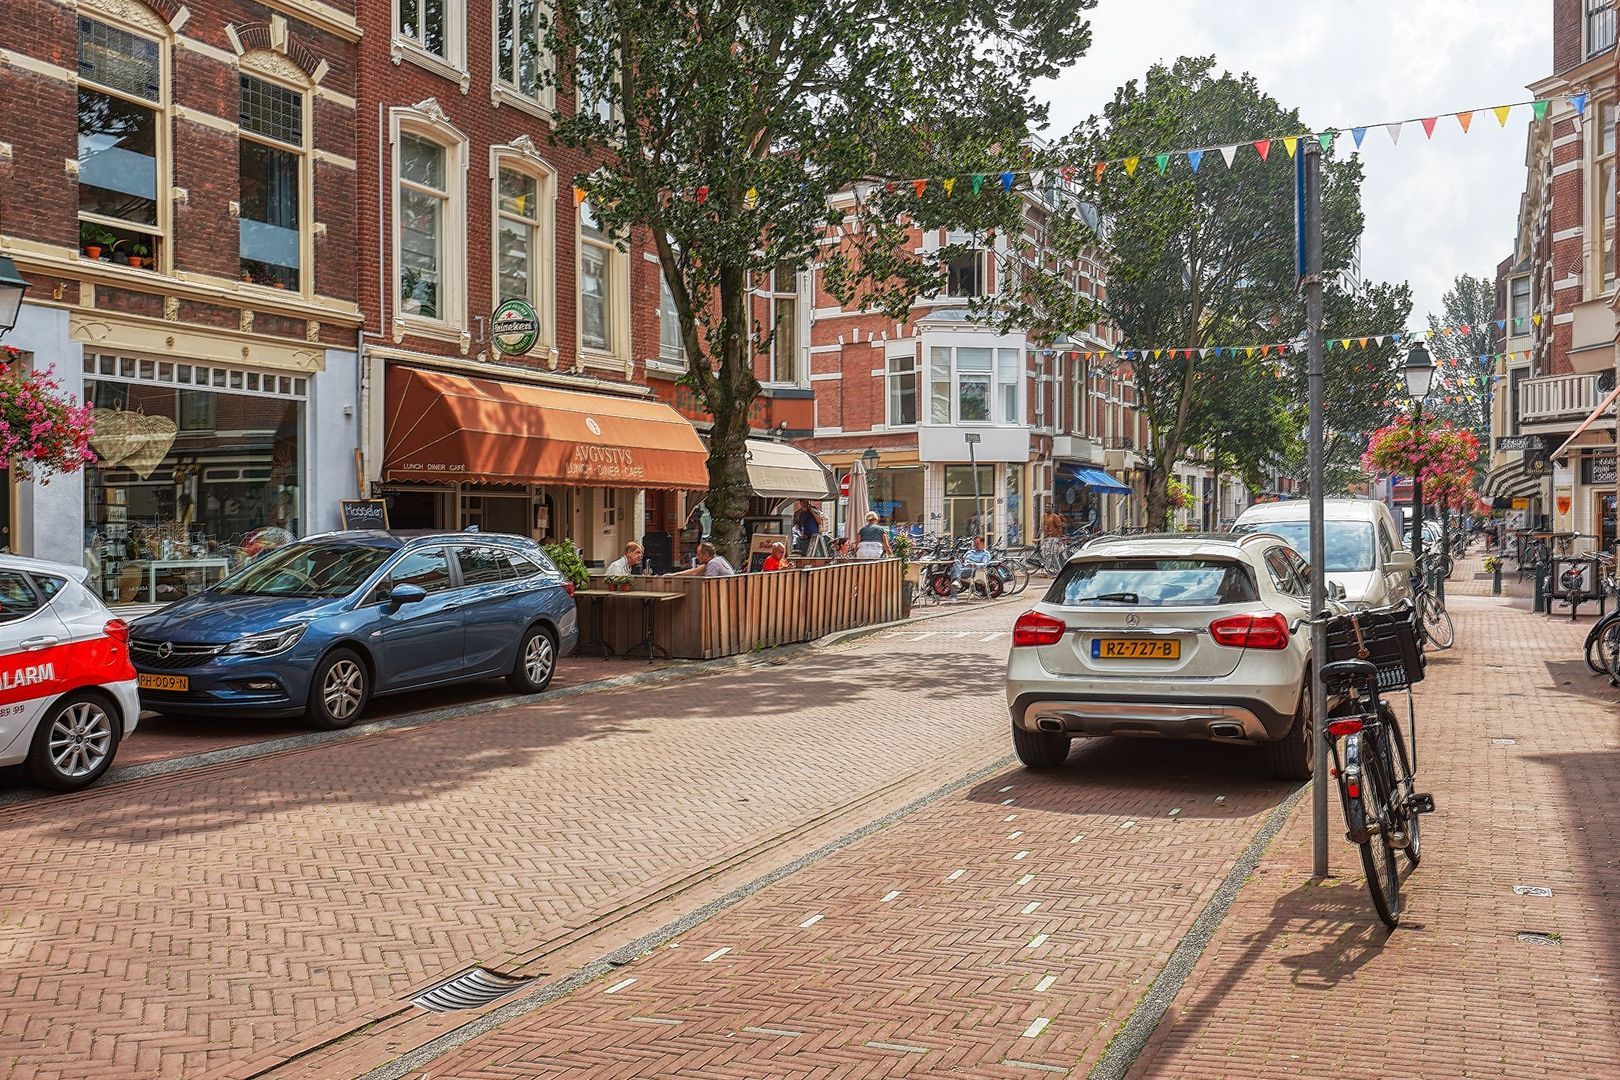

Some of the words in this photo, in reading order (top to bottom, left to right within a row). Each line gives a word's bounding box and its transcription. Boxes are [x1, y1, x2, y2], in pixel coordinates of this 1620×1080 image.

[575, 446, 632, 465] AVGVSTVS
[427, 463, 446, 471] DINER
[566, 462, 592, 475] LUNCH
[597, 465, 620, 477] DINER
[345, 504, 383, 518] Mosselen
[1106, 642, 1172, 656] RZ-727-B
[140, 675, 187, 690] PH-009-N
